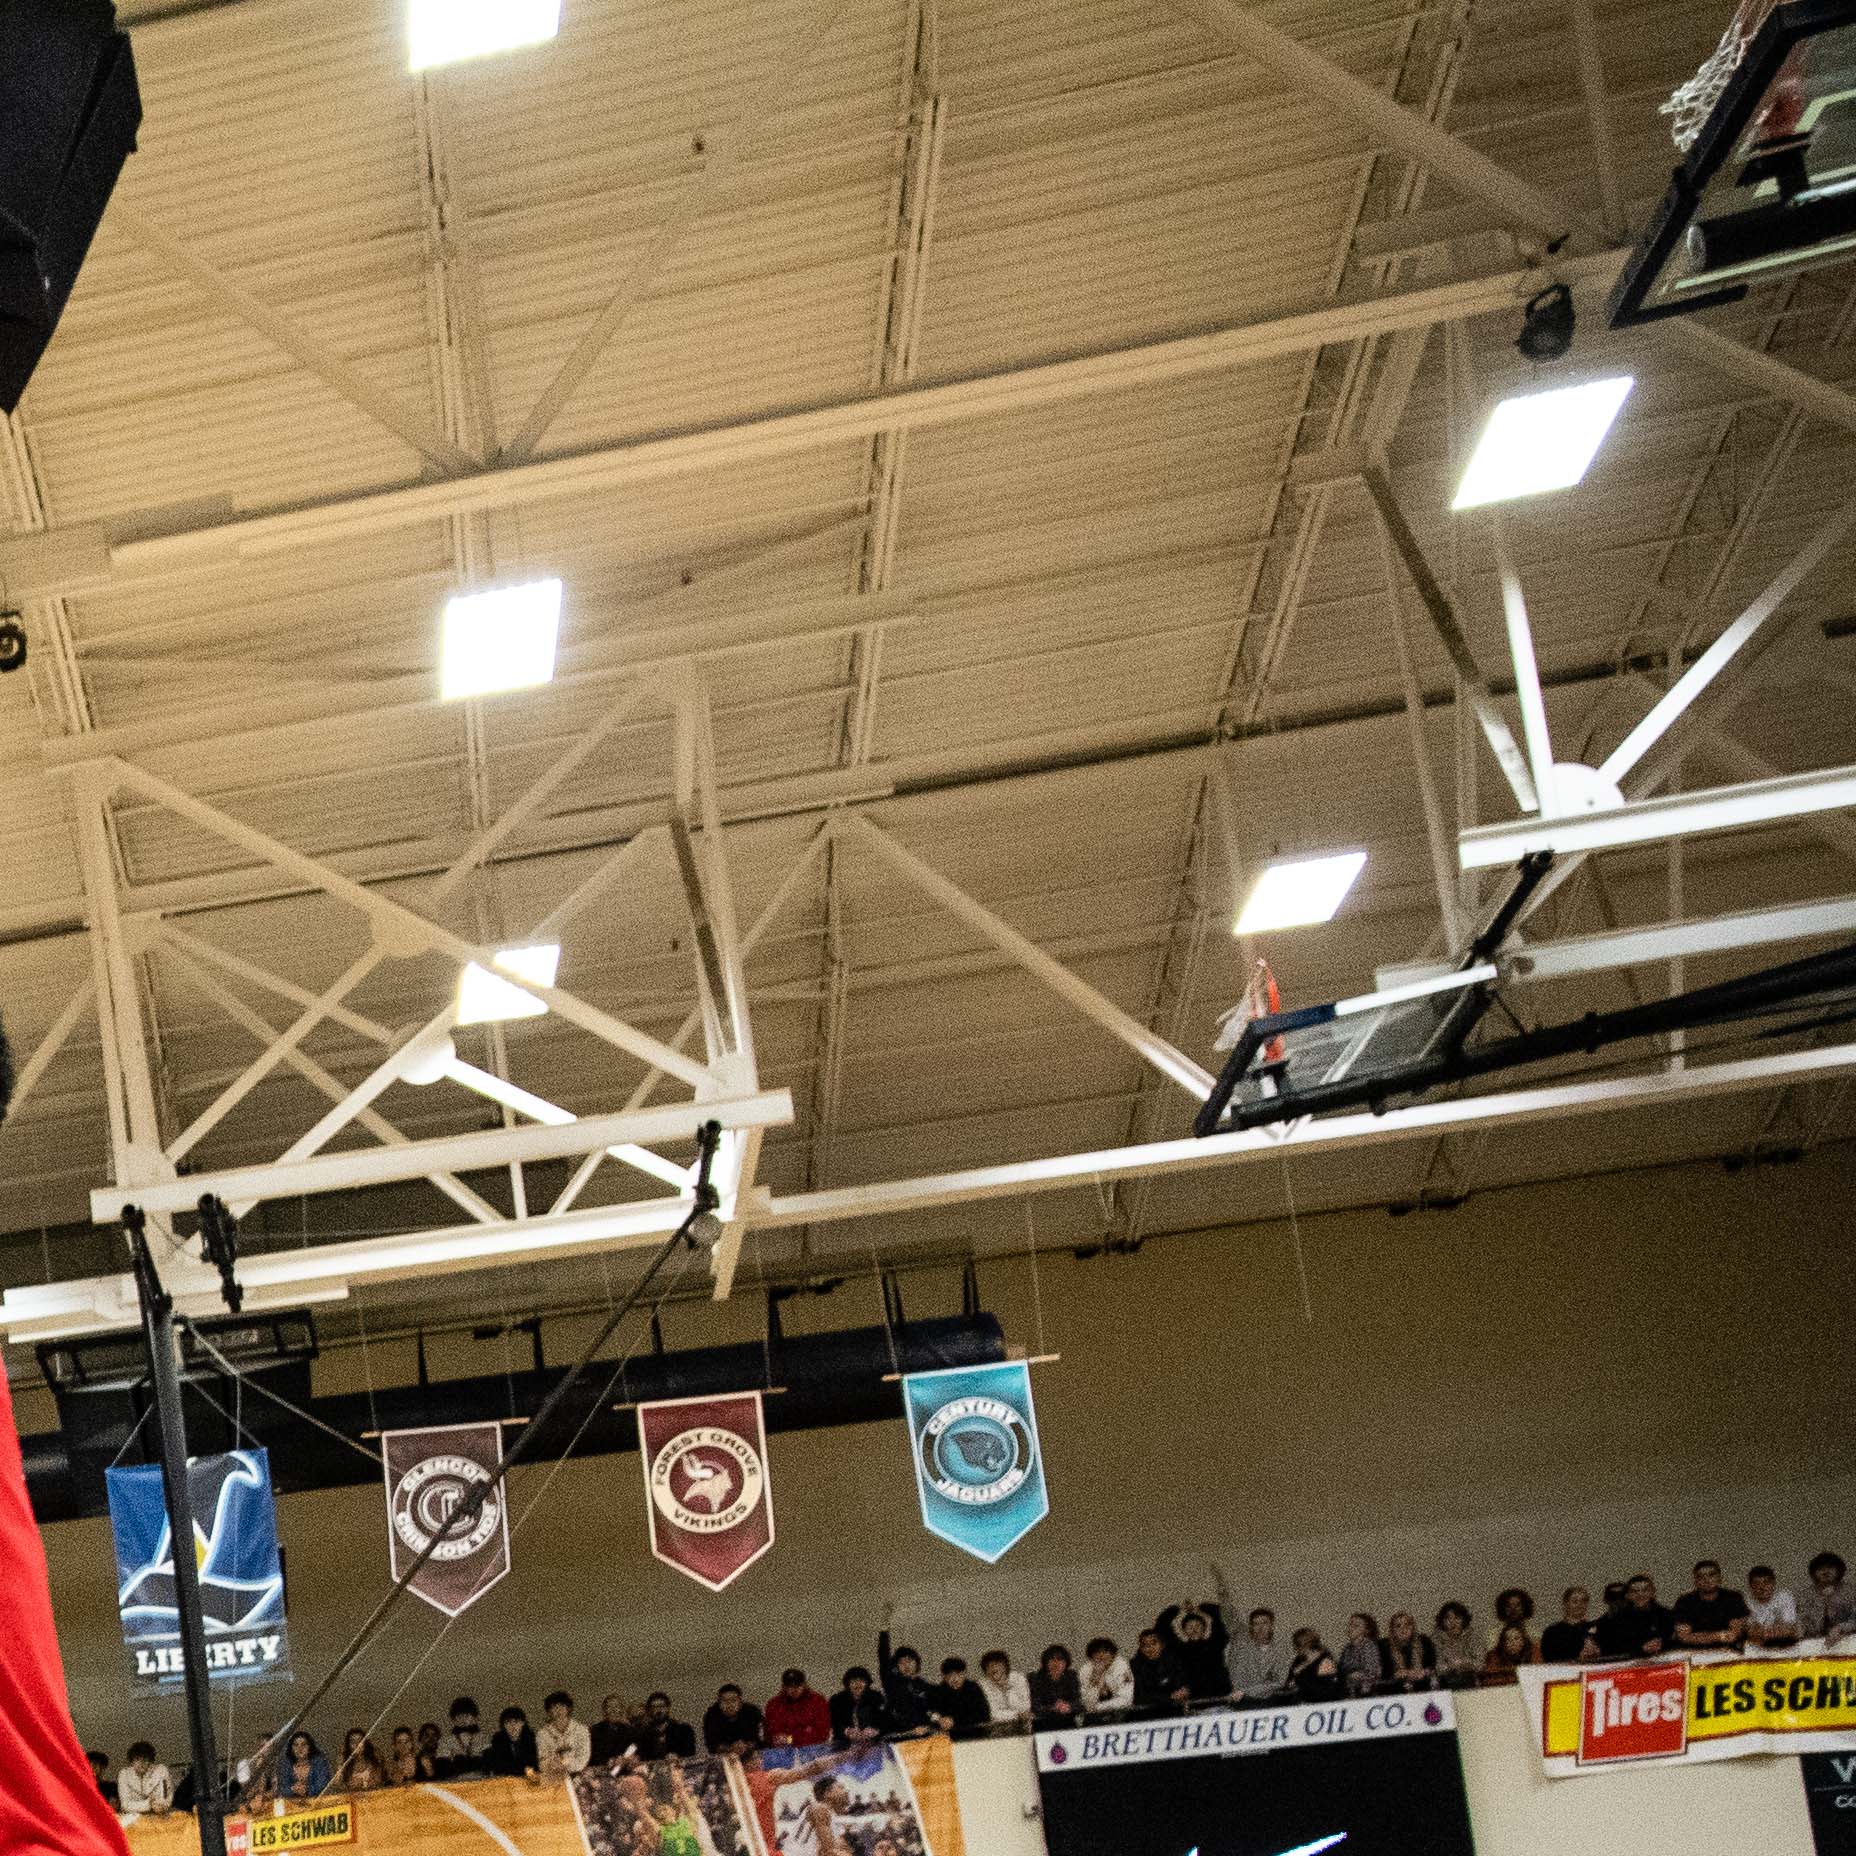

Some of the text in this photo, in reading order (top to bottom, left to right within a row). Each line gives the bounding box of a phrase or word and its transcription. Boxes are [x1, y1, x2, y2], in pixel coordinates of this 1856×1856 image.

[926, 1399, 1019, 1436] CENTURY
[654, 1431, 758, 1487] FOREST GROVE
[672, 1503, 748, 1530] VIKINGS
[1587, 1679, 1682, 1738] Tires
[1696, 1678, 1756, 1720] LES
[1080, 1701, 1412, 1761] BRETTHAUER OIL CO.
[252, 1825, 277, 1847] LES
[280, 1812, 348, 1842] SCHWAB
